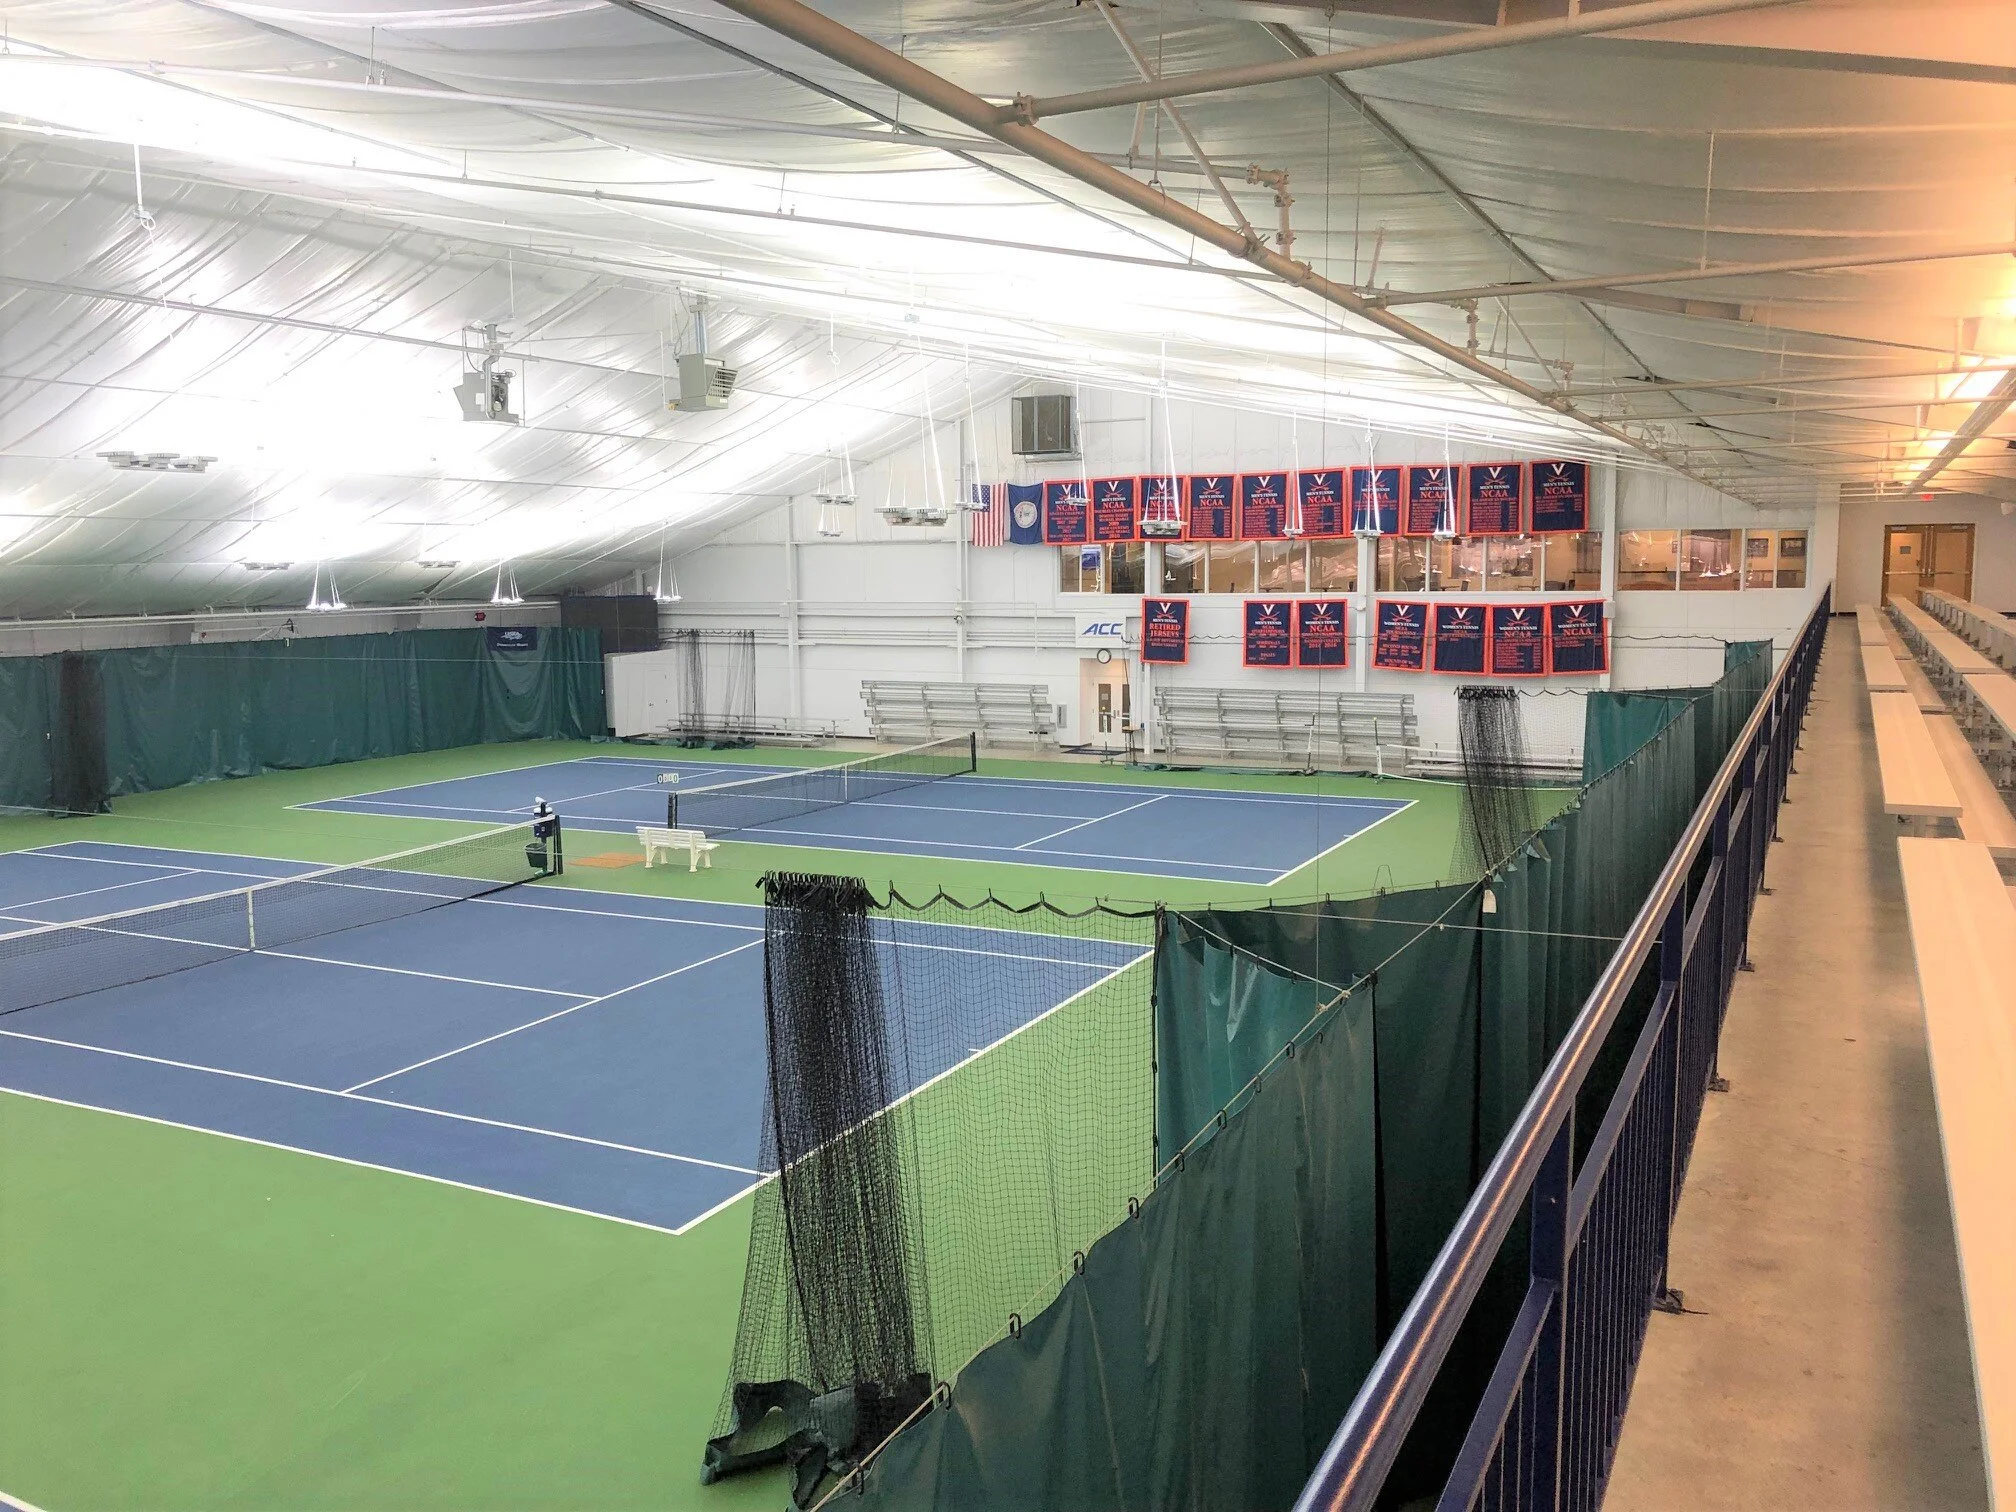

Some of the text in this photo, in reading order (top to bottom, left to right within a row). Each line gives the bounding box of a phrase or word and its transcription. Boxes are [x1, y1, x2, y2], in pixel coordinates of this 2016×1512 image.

[1428, 469, 1441, 480] V
[1488, 467, 1502, 479] V
[1552, 463, 1565, 476] V
[1156, 479, 1168, 490] V
[1206, 477, 1218, 489] V
[1258, 476, 1271, 488] V
[1313, 473, 1326, 485] V
[1061, 484, 1072, 495] V
[1107, 481, 1119, 492] V
[1544, 487, 1573, 495] NCAA
[1307, 495, 1333, 504] NCAA
[1481, 490, 1509, 498] NCAA
[1252, 498, 1277, 506] NCAA
[1159, 602, 1172, 614] V
[1262, 604, 1275, 615] V
[1315, 603, 1329, 615] V
[1396, 604, 1410, 616] V
[1454, 607, 1469, 619] V
[1511, 608, 1526, 620] V
[1569, 604, 1585, 617] V
[1082, 623, 1123, 635] ACC
[1310, 624, 1335, 633] NCAA
[1563, 628, 1592, 636] NCAA
